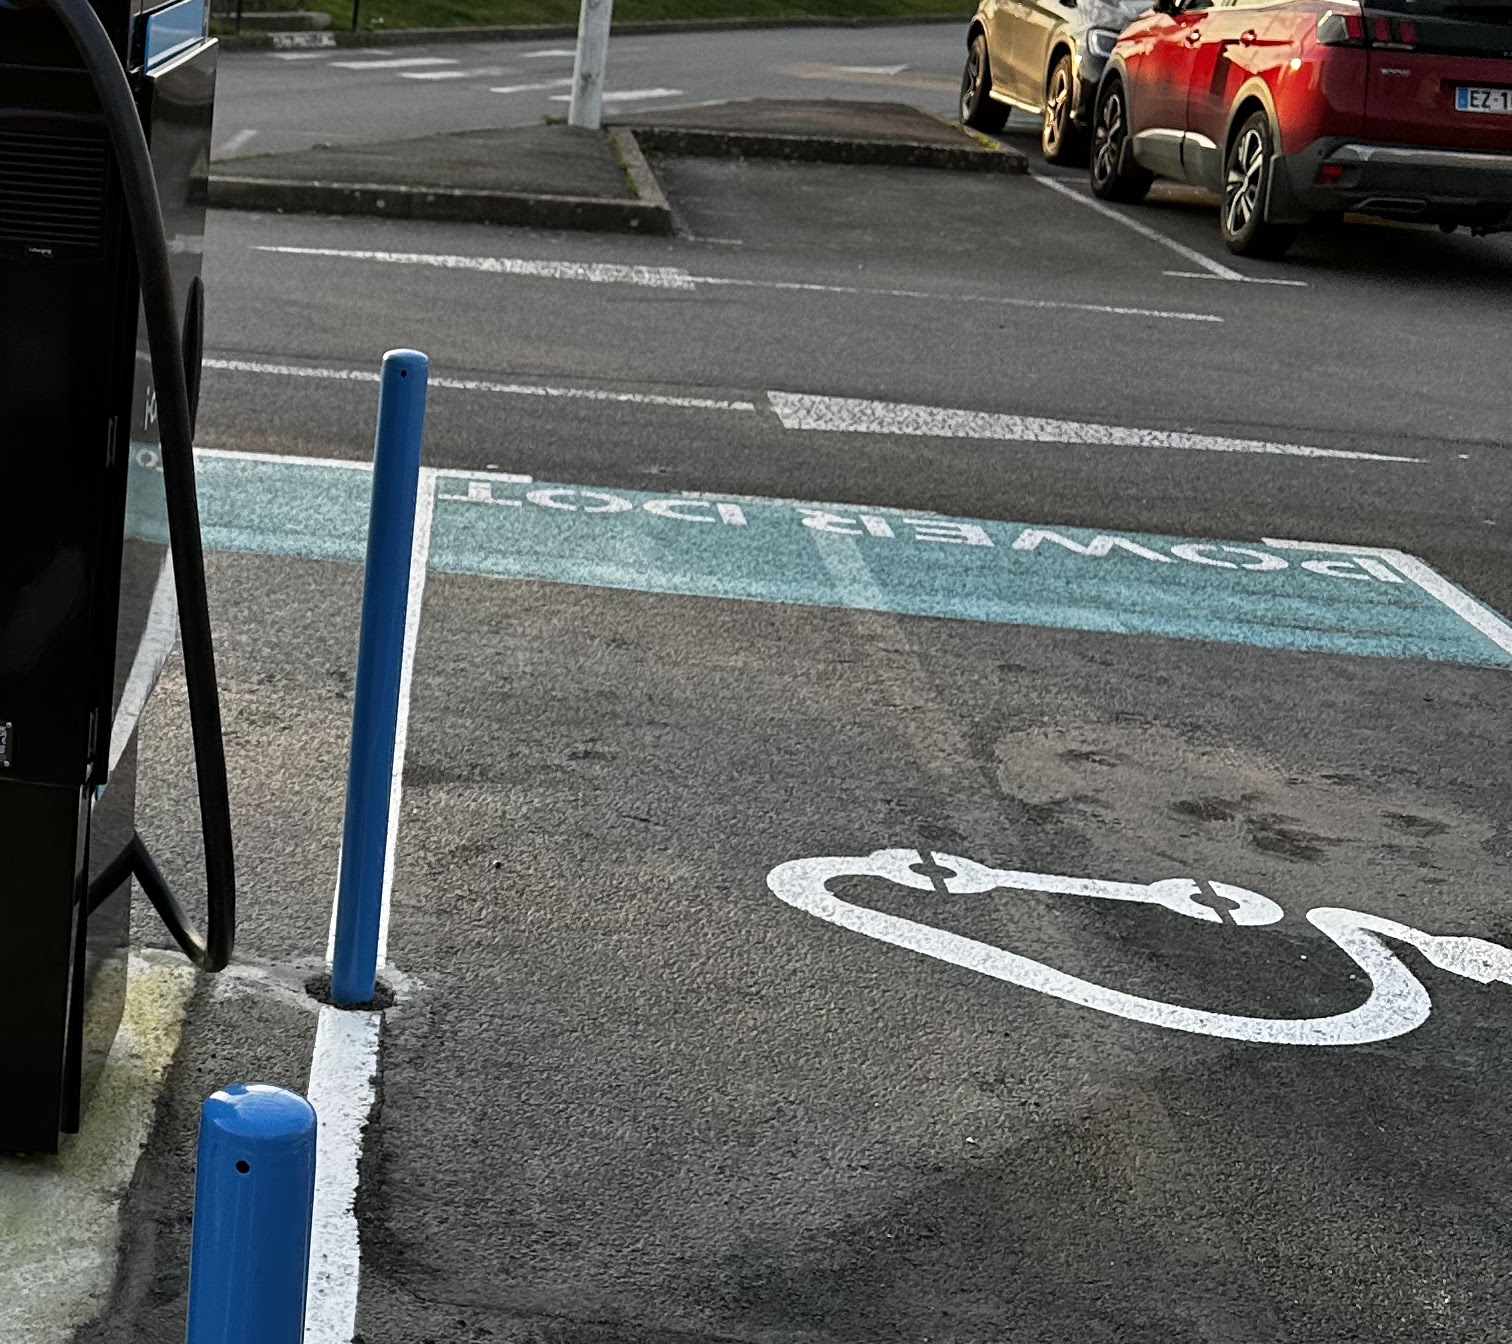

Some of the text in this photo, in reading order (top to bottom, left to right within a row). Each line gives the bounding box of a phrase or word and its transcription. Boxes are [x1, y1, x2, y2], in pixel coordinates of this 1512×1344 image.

[1470, 90, 1512, 111] EZ-1
[437, 481, 1408, 584] POWER DOT
